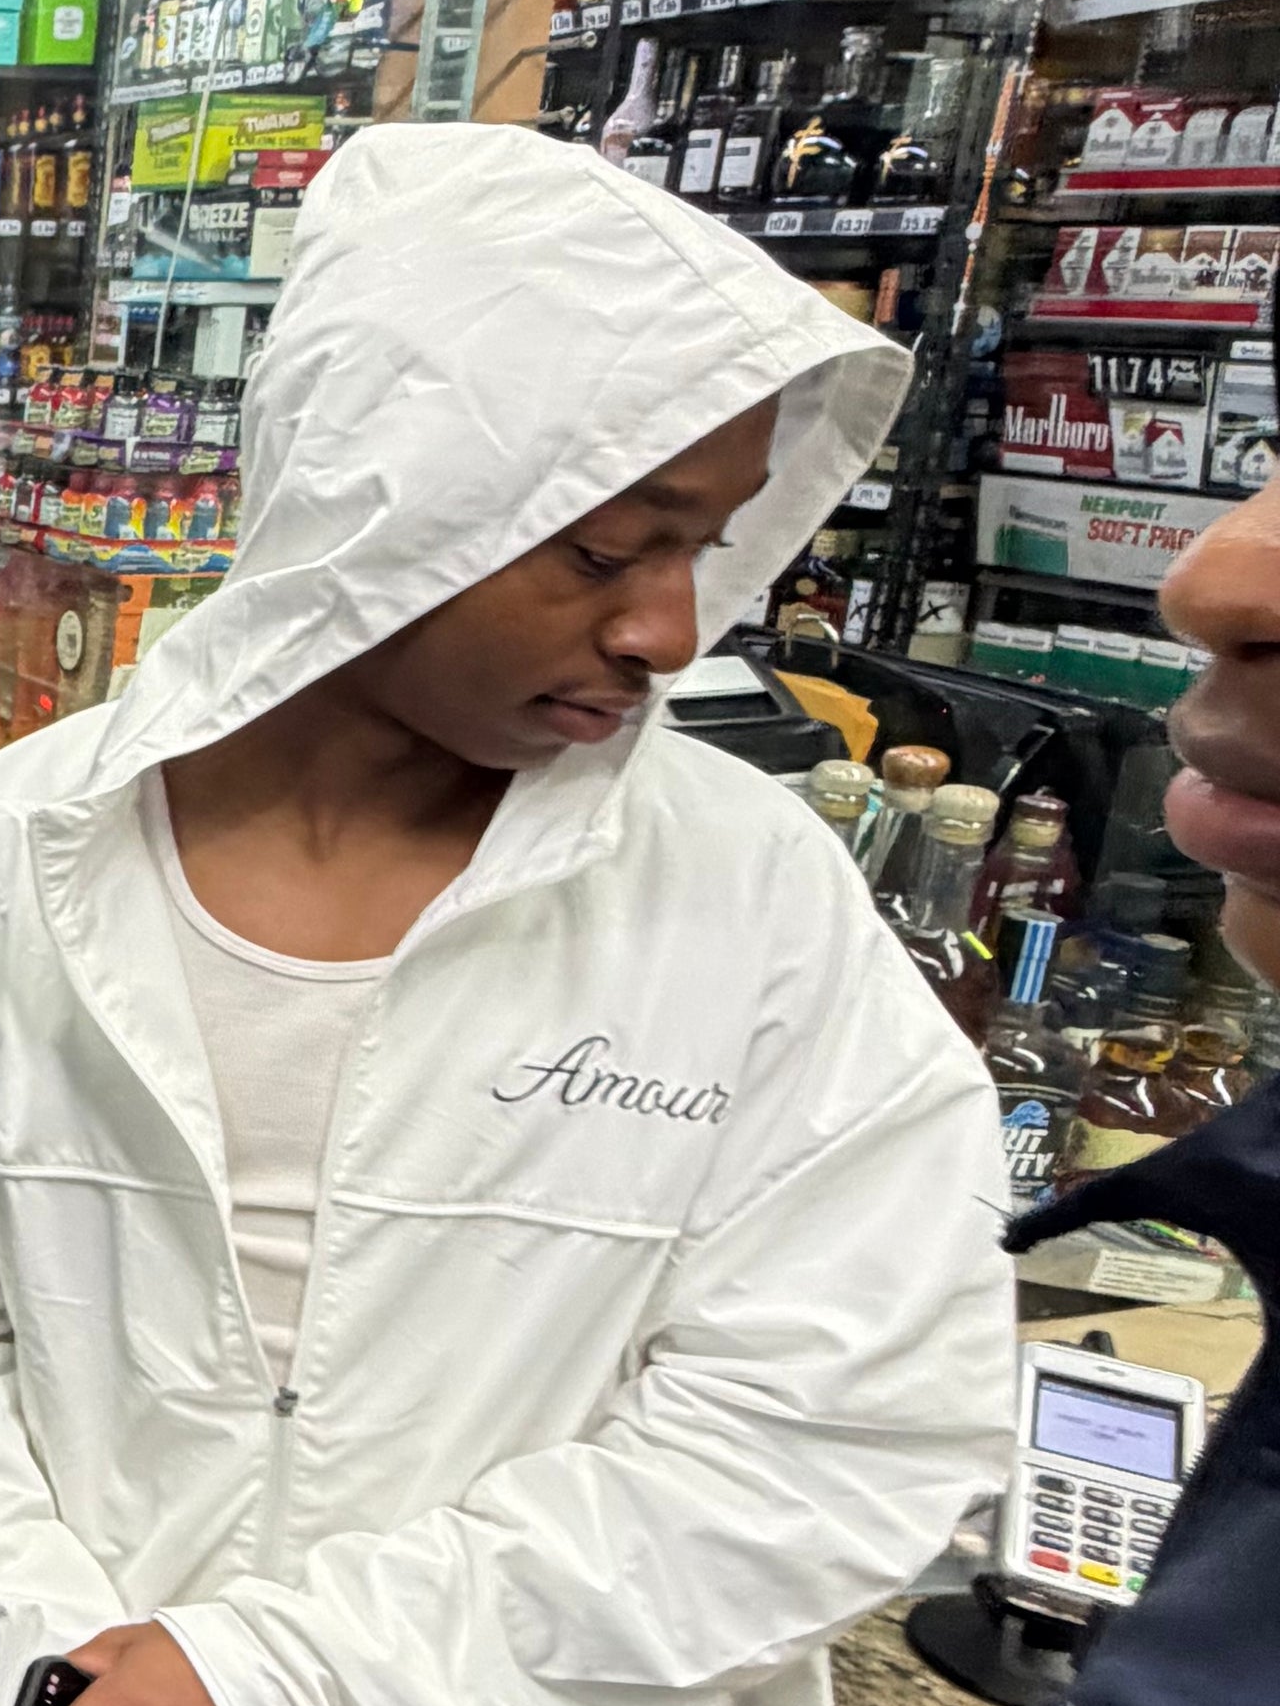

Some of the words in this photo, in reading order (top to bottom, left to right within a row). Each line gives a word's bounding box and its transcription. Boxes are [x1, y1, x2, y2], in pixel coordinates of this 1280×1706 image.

[245, 111, 301, 133] TWANG
[1003, 393, 1110, 452] Marlboro
[1080, 494, 1168, 521] NEWPORT
[1087, 518, 1148, 547] SOFT
[1148, 522, 1200, 551] PAC
[492, 1035, 731, 1124] Amour
